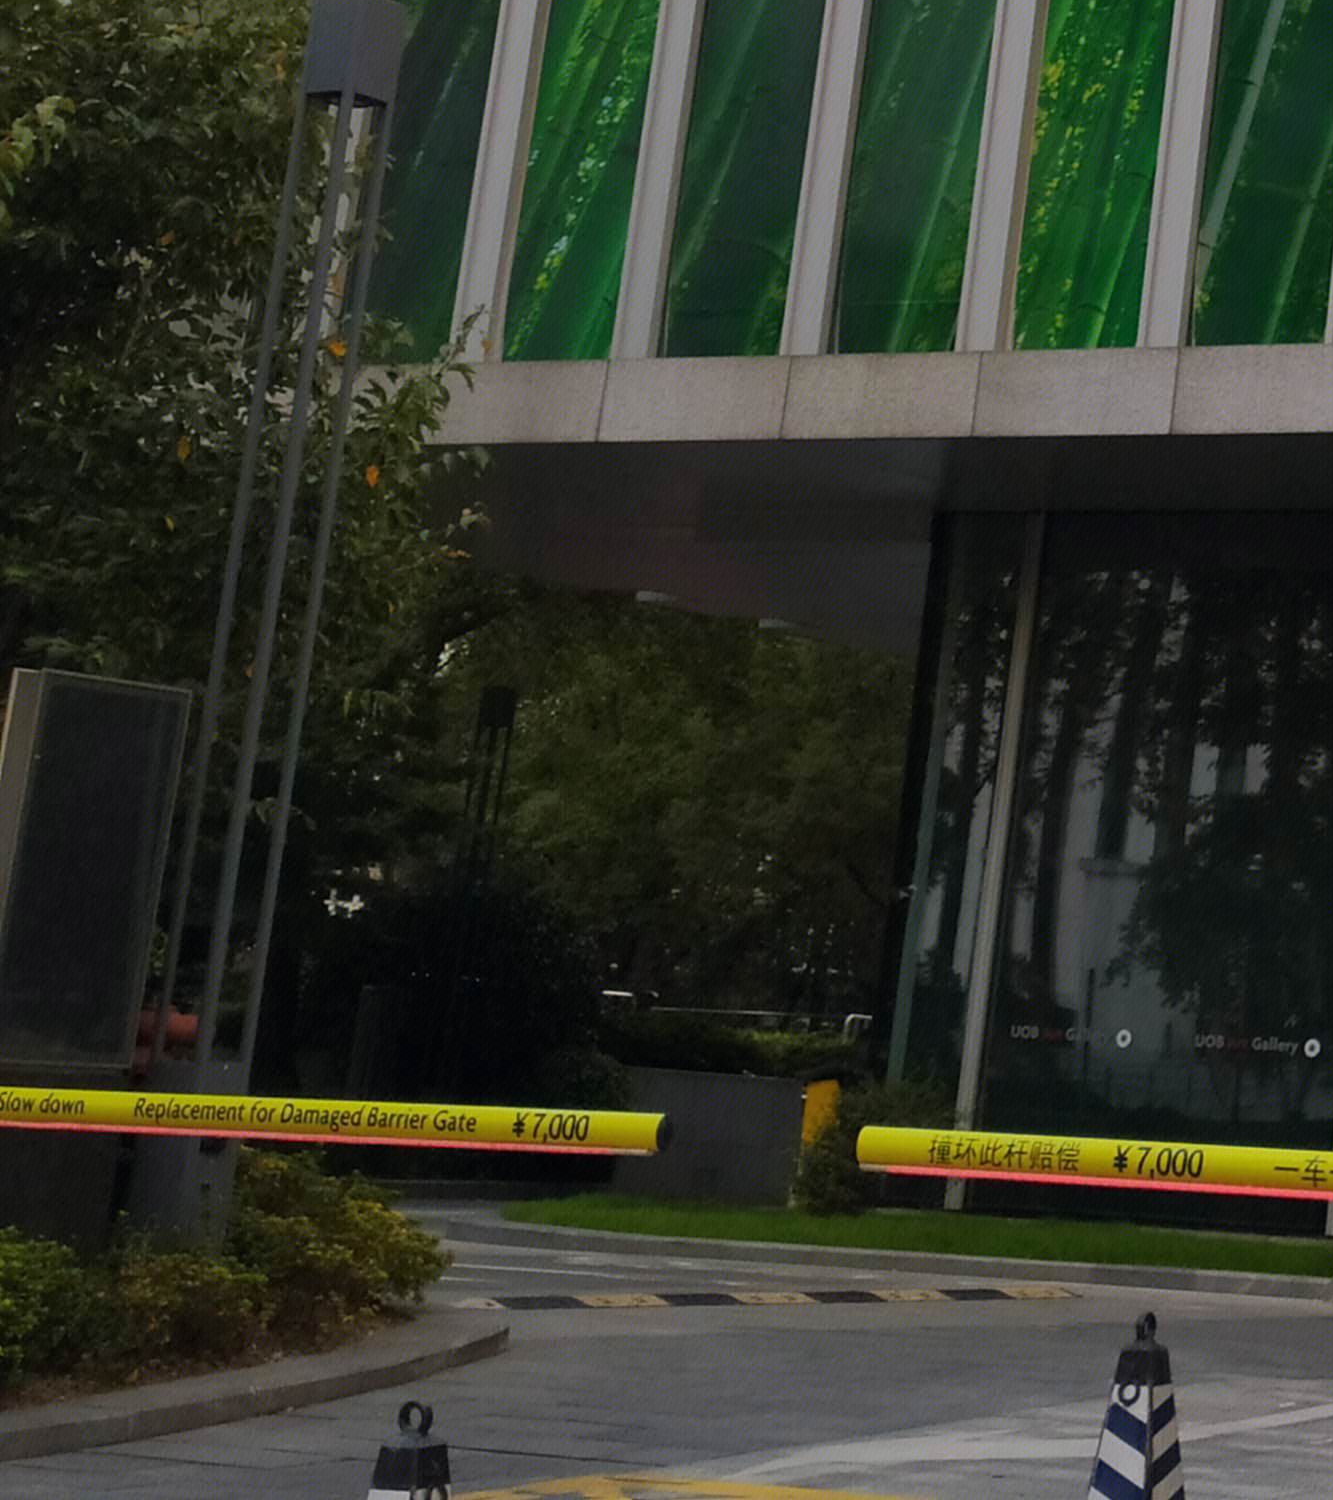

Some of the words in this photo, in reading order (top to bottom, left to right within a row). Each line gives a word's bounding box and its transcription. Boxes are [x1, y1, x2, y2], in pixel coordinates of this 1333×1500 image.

[1251, 1036, 1300, 1057] Gallery
[39, 1092, 85, 1115] down
[134, 1097, 245, 1125] Replacement
[250, 1100, 278, 1123] for
[280, 1103, 366, 1133] Damaged
[367, 1107, 427, 1131] Barrier
[433, 1110, 477, 1134] Gate
